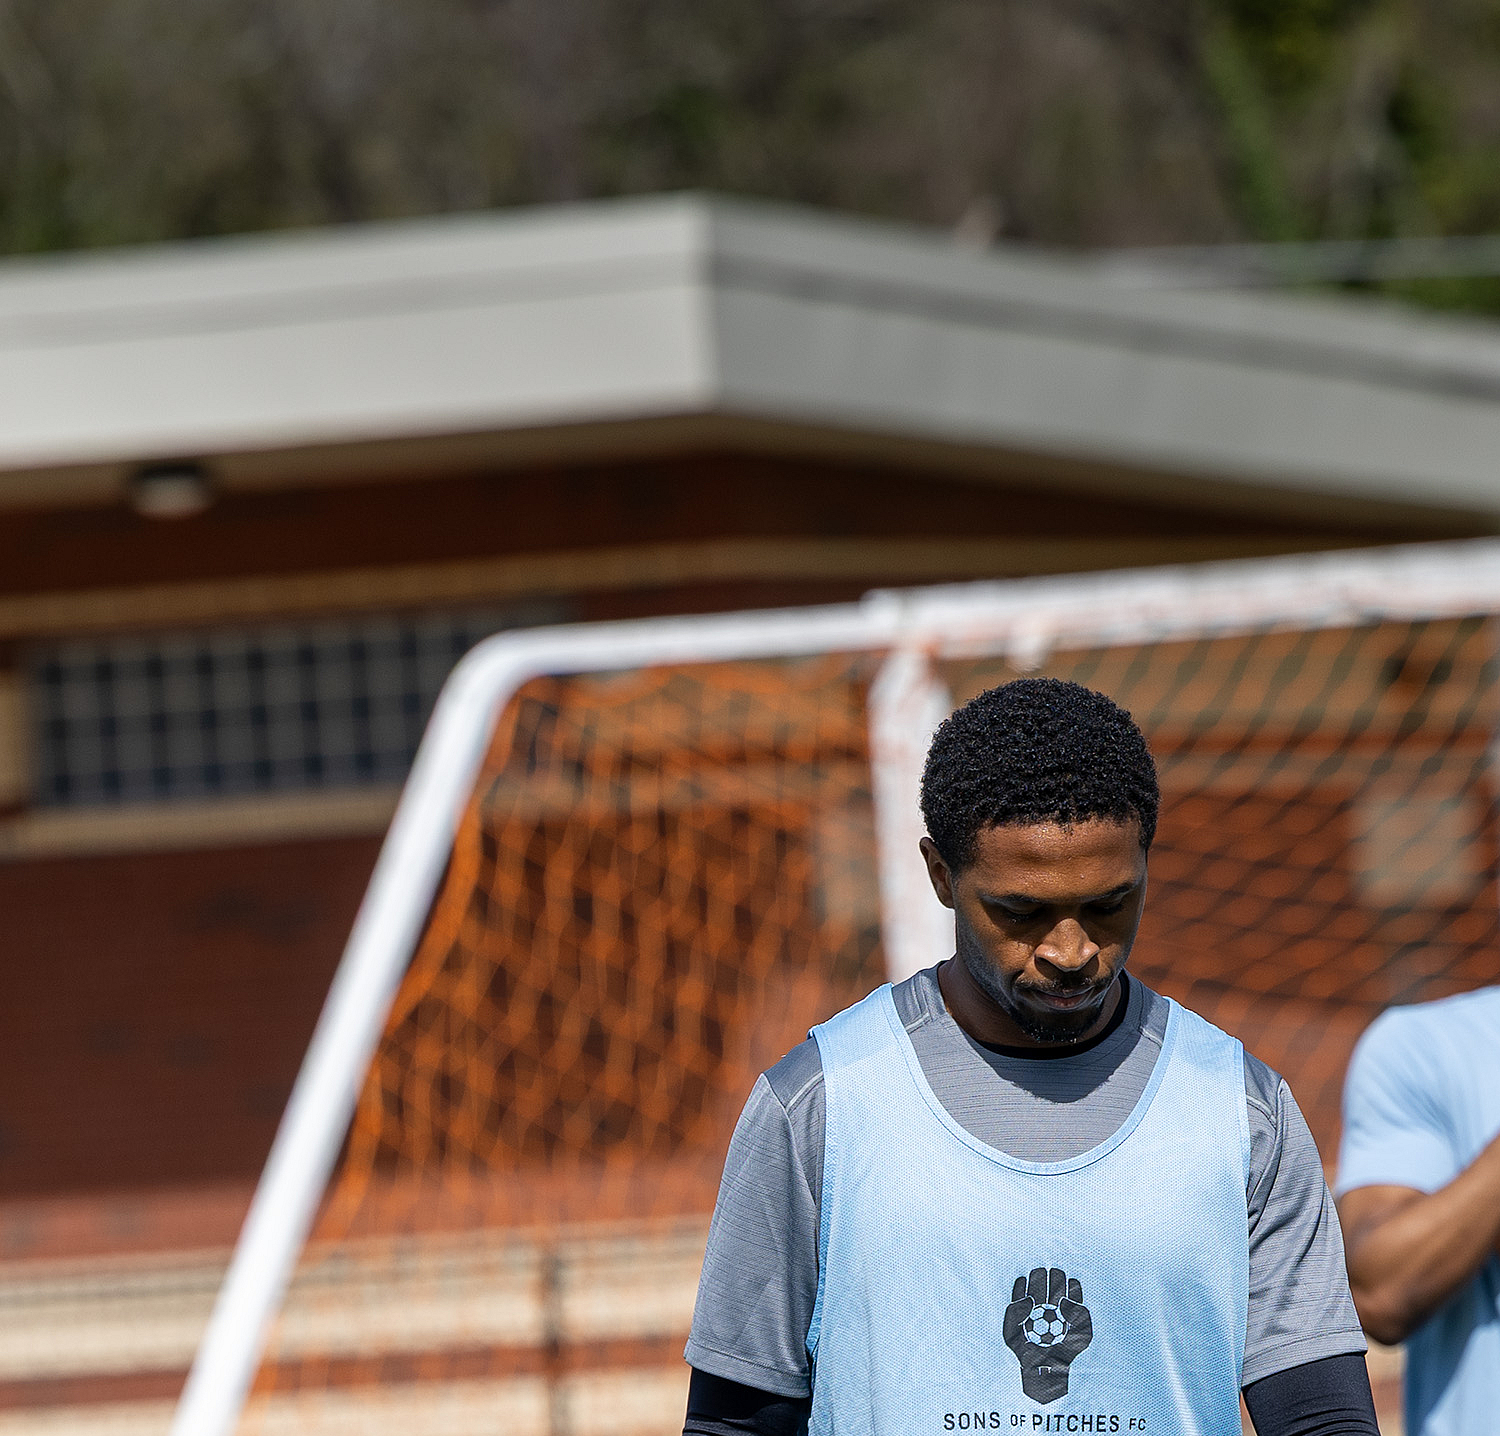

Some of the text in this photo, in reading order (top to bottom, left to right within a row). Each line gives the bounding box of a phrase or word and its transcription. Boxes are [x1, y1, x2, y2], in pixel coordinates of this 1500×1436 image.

[943, 1411, 1147, 1433] SONS OF PITCHES FC
